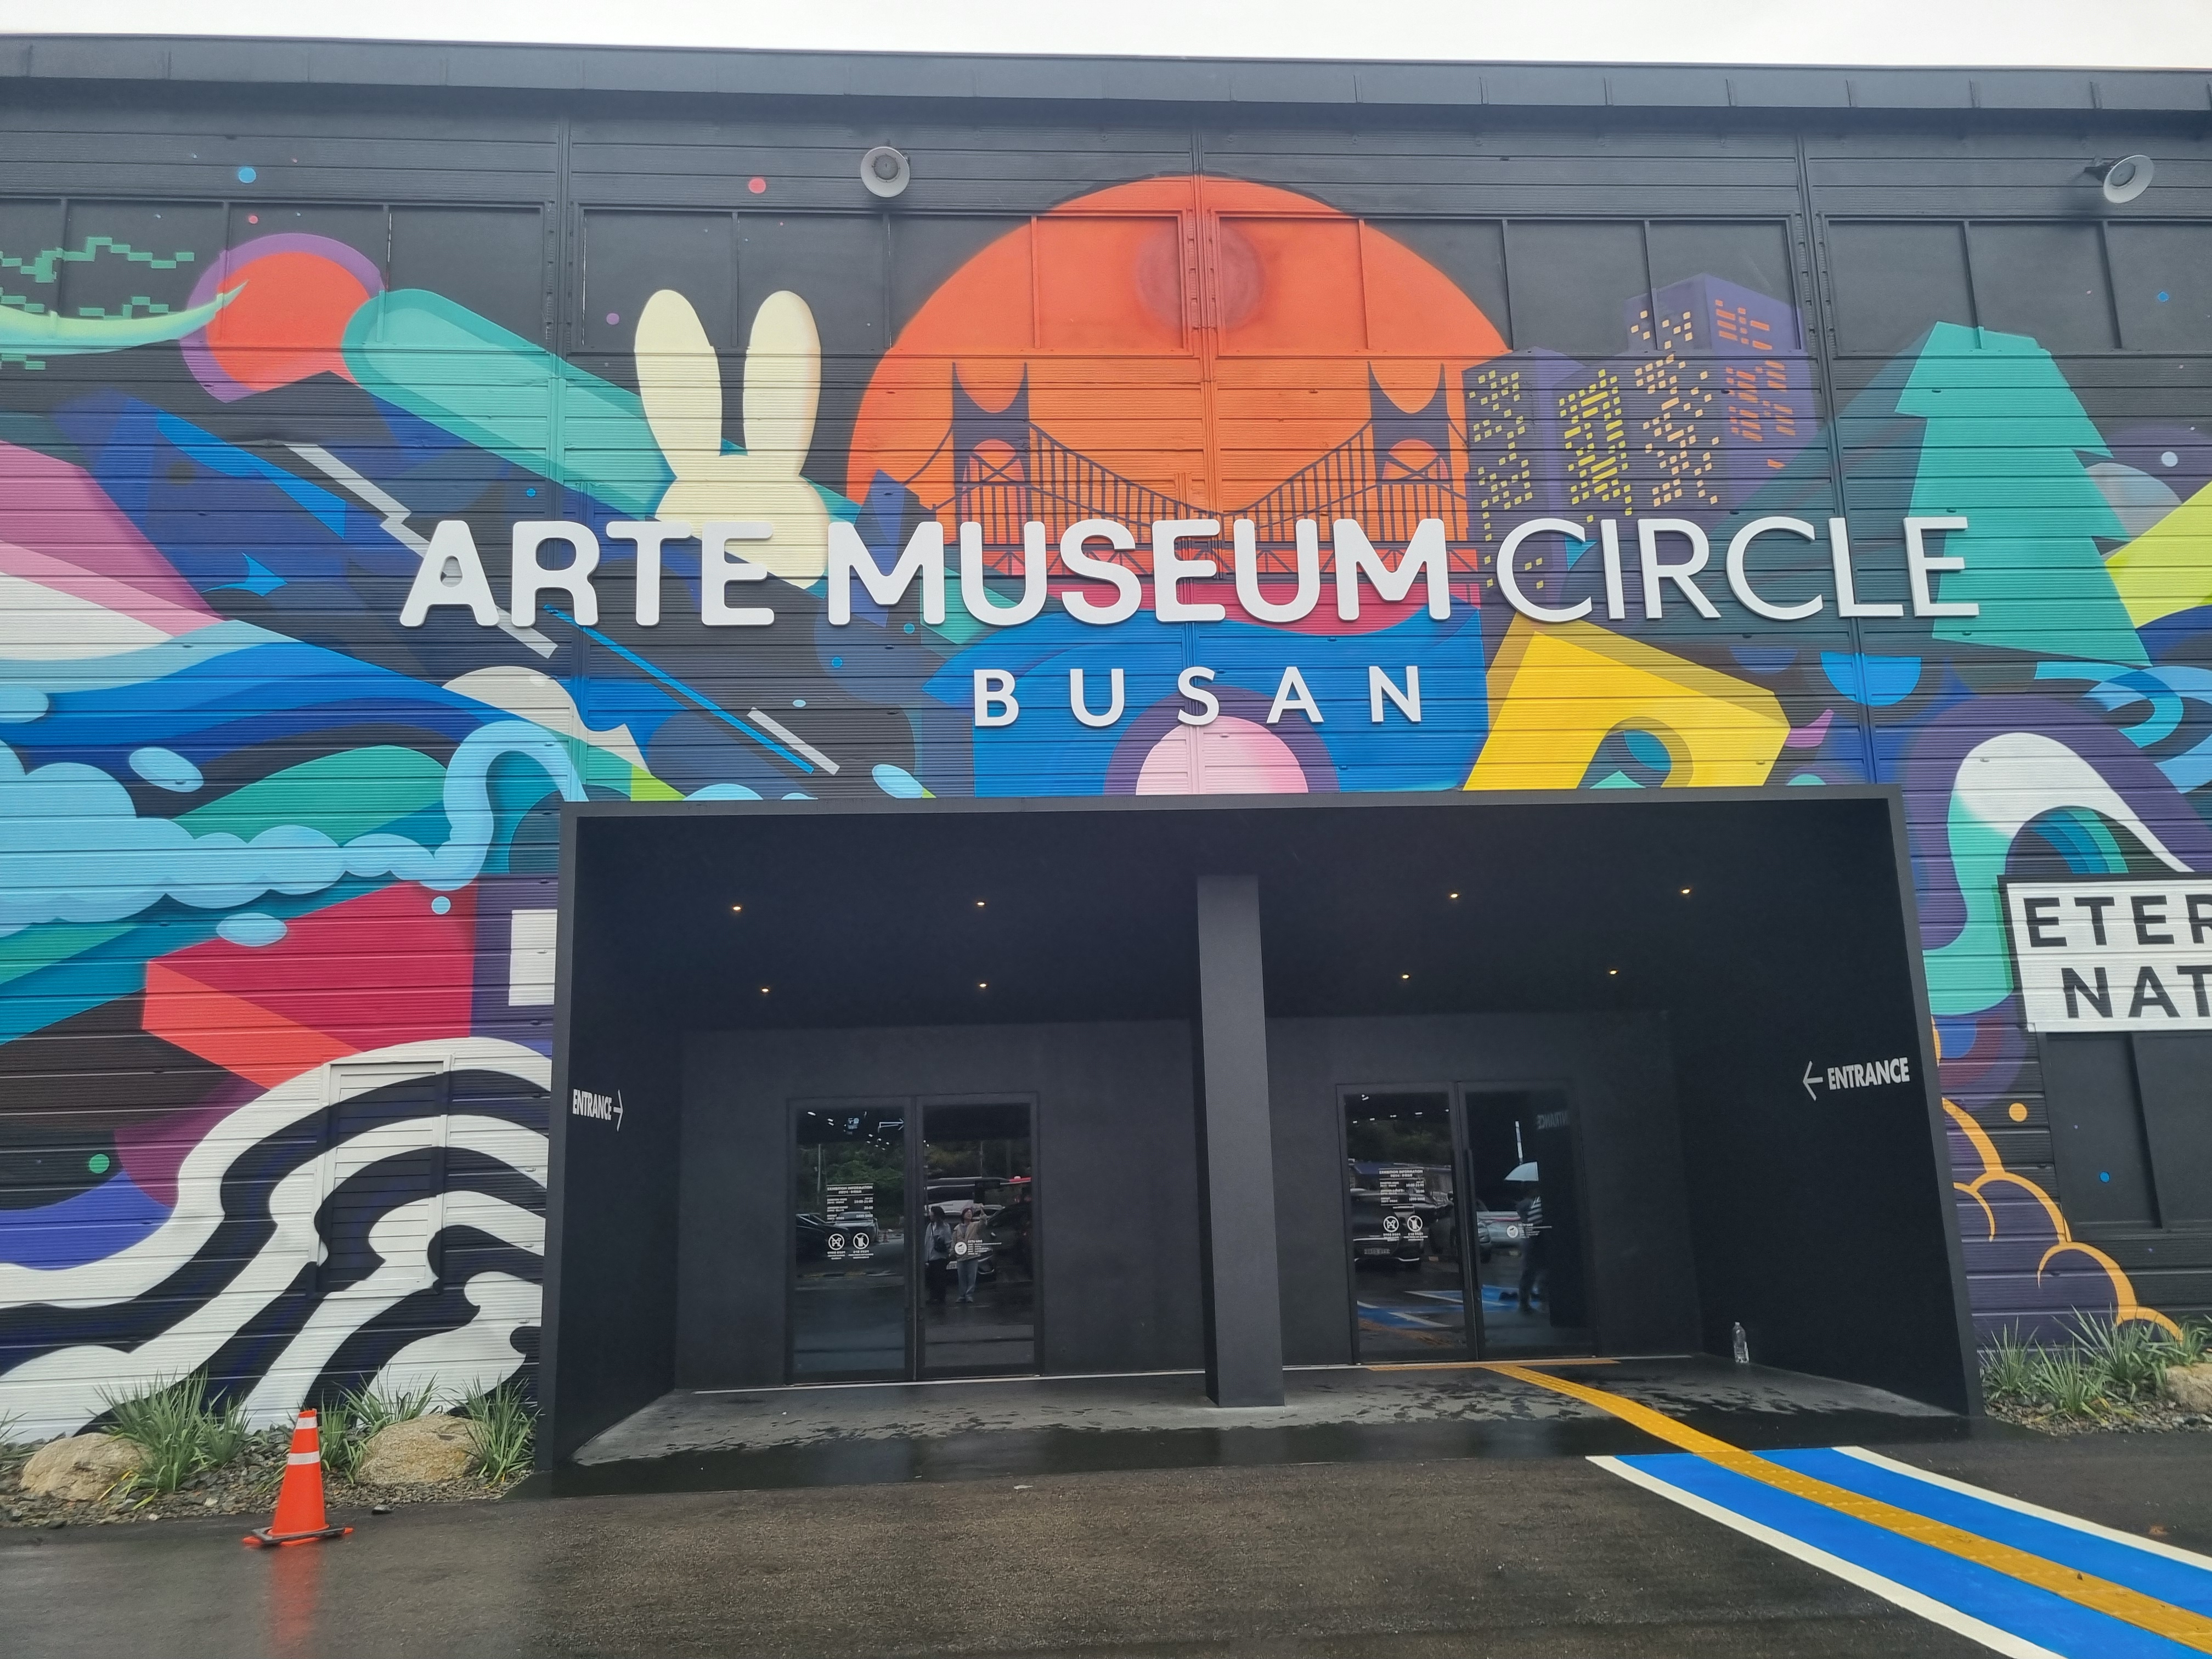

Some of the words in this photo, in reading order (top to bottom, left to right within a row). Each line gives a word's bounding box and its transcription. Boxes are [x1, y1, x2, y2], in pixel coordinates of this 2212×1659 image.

[399, 520, 775, 627] ARTE
[828, 518, 1451, 625] MUSEUM
[1496, 516, 1979, 622] CIRCLE
[974, 666, 1421, 726] BUSAN
[2061, 965, 2212, 1019] NAT
[1827, 1057, 1910, 1091] ENTRANCE
[572, 1088, 612, 1121] ENTRANCE
